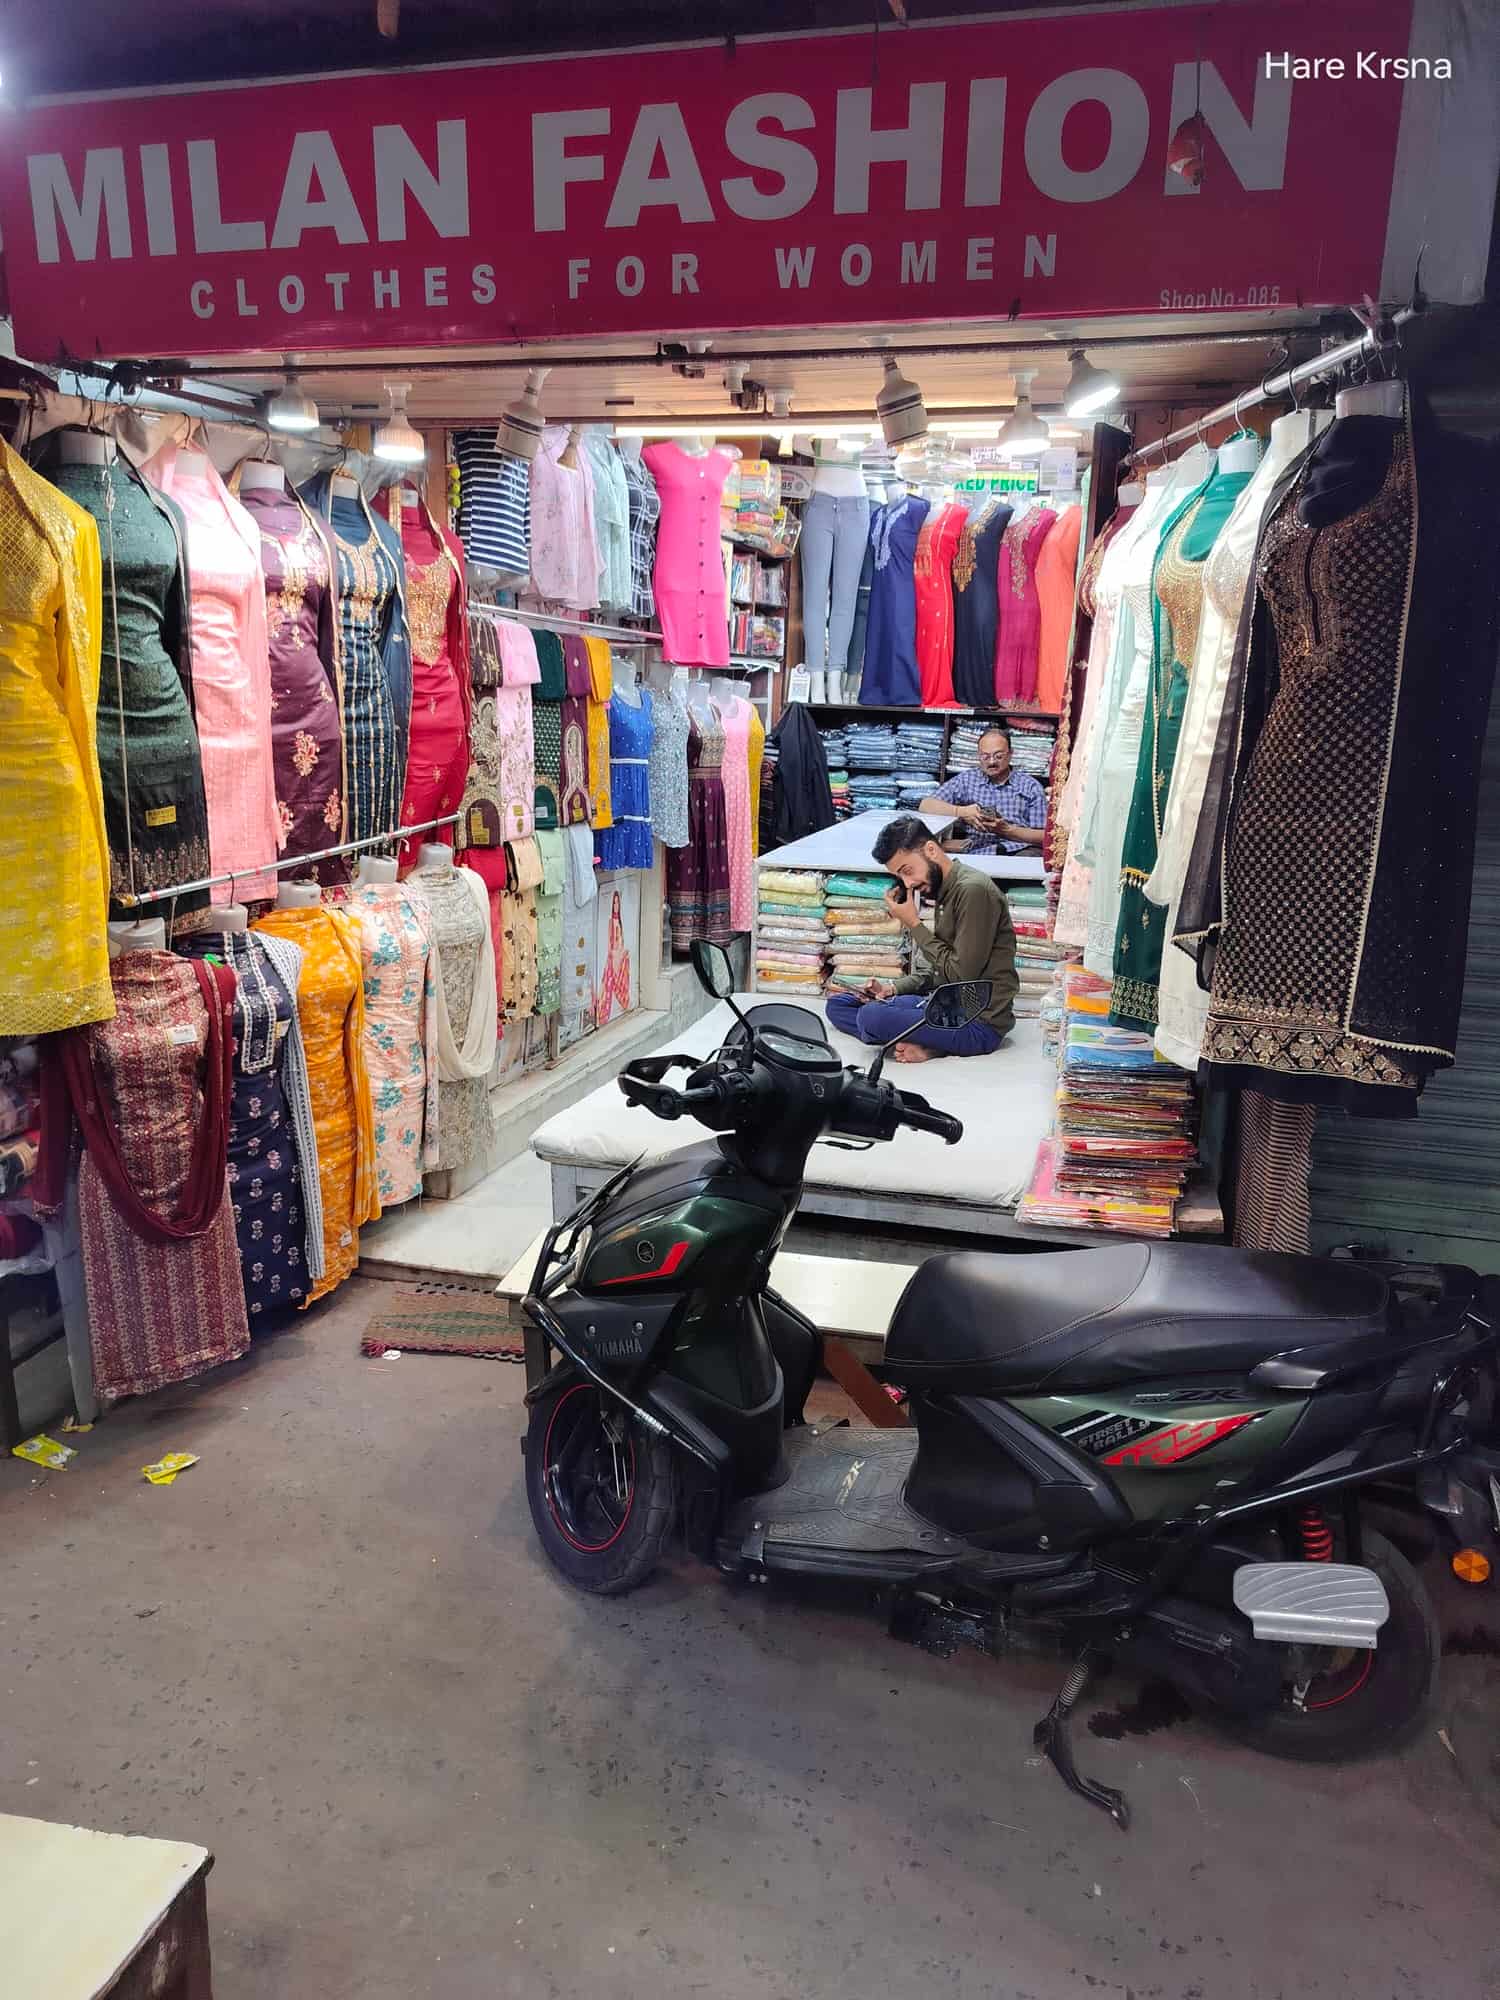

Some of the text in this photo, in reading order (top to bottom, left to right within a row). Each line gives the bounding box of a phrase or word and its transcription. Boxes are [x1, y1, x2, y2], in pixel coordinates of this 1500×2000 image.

[26, 57, 1294, 264] MILAN FASHION
[191, 234, 1057, 319] CLOTHES FOR WOMEN
[594, 1336, 643, 1358] YAMAHA
